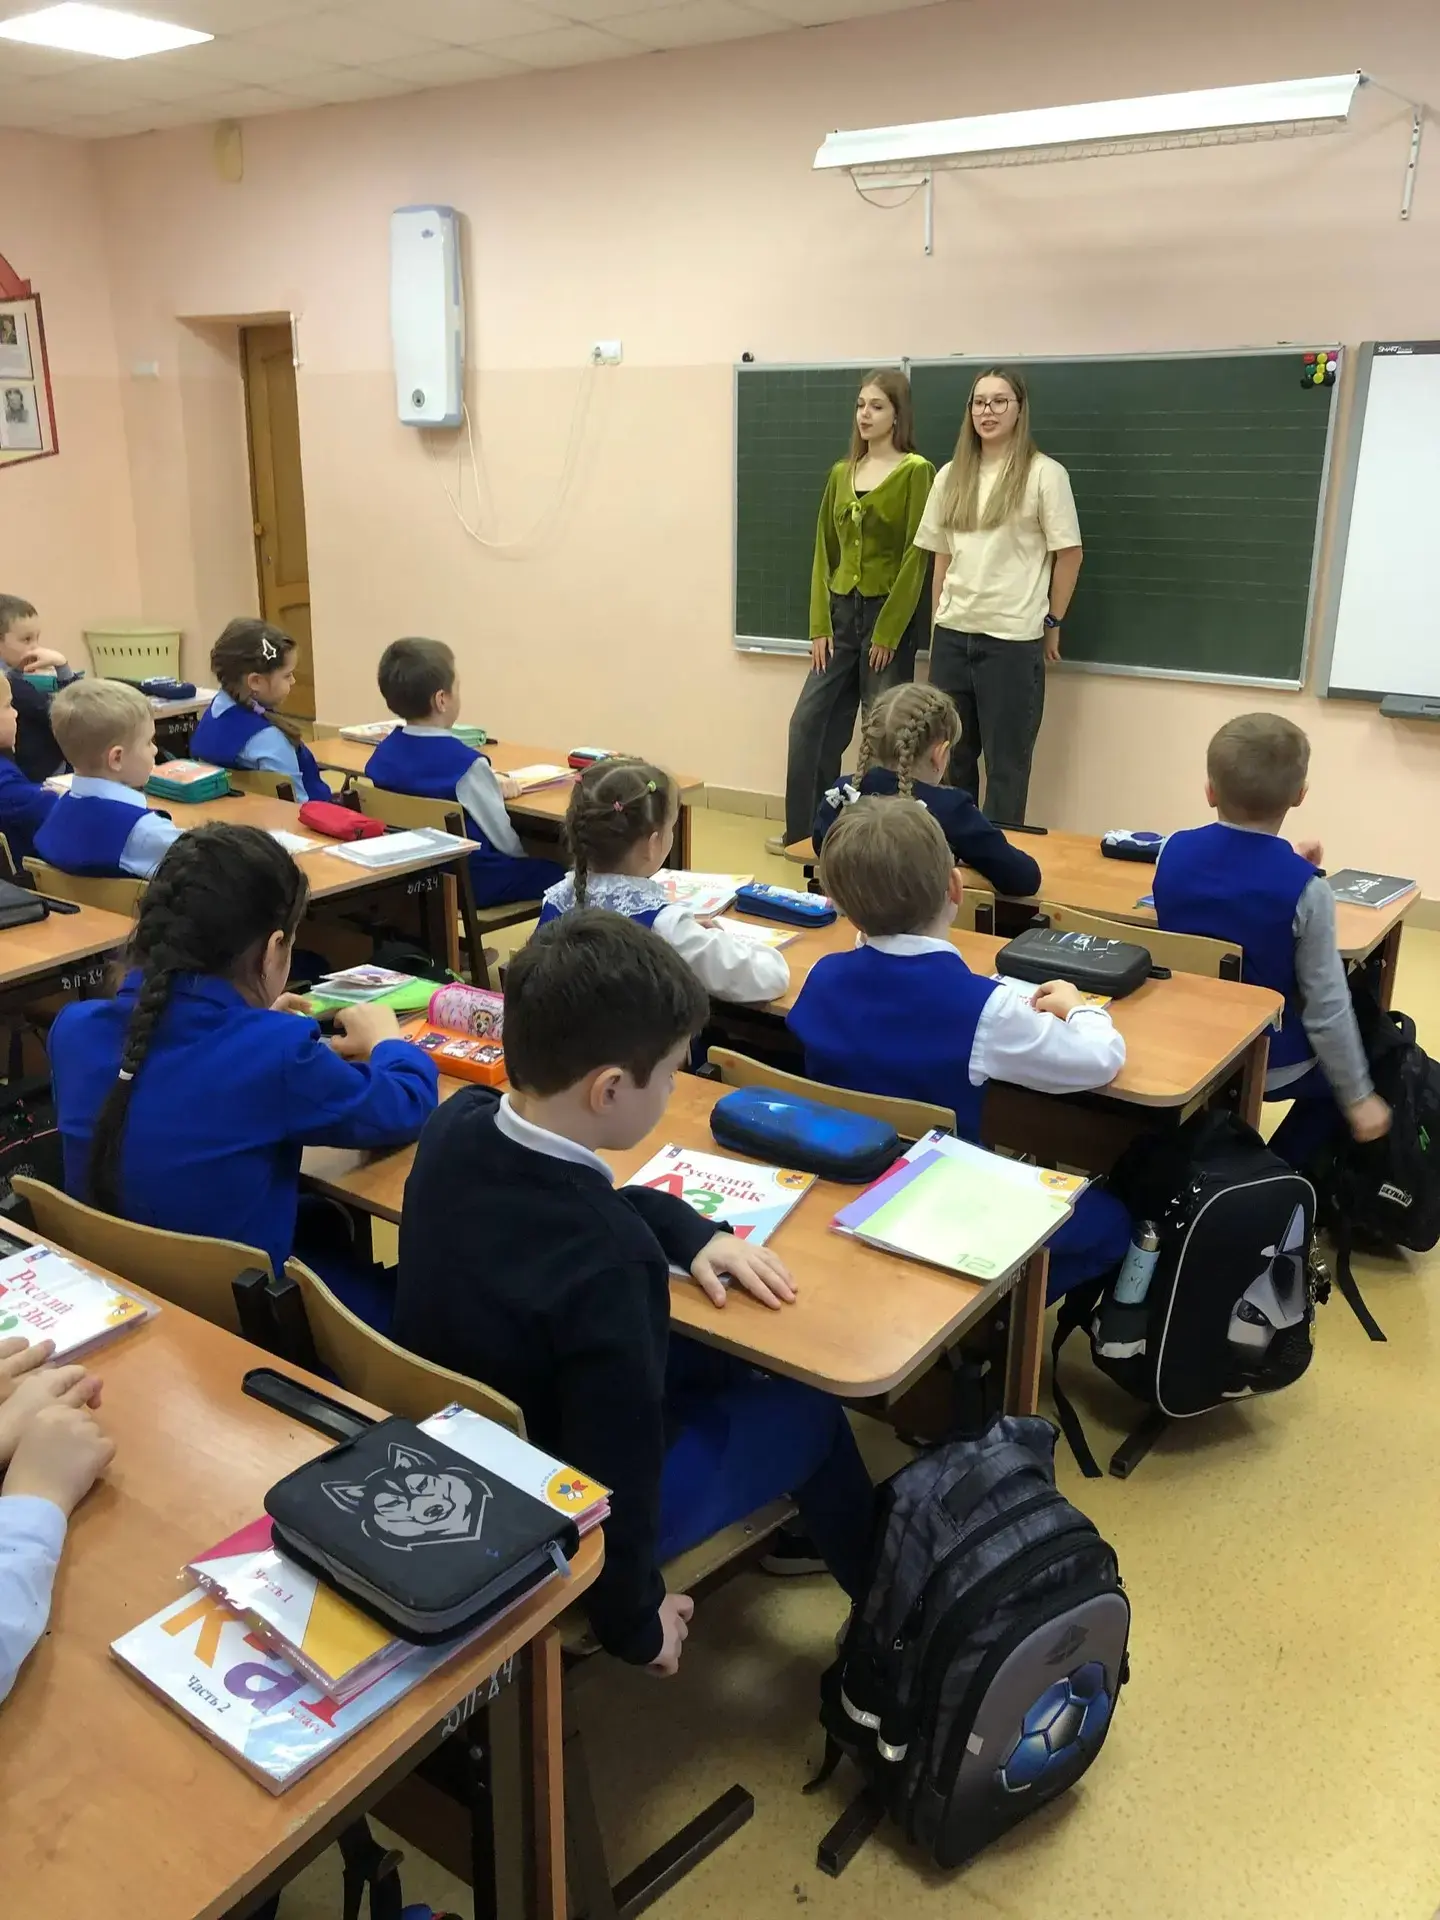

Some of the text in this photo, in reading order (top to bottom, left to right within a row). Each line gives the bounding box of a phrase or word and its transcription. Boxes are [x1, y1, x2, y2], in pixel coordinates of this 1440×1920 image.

[1378, 345, 1399, 353] SMART
[672, 1161, 755, 1189] Русский
[956, 1253, 996, 1275] 12
[188, 1674, 232, 1714] Часть 2
